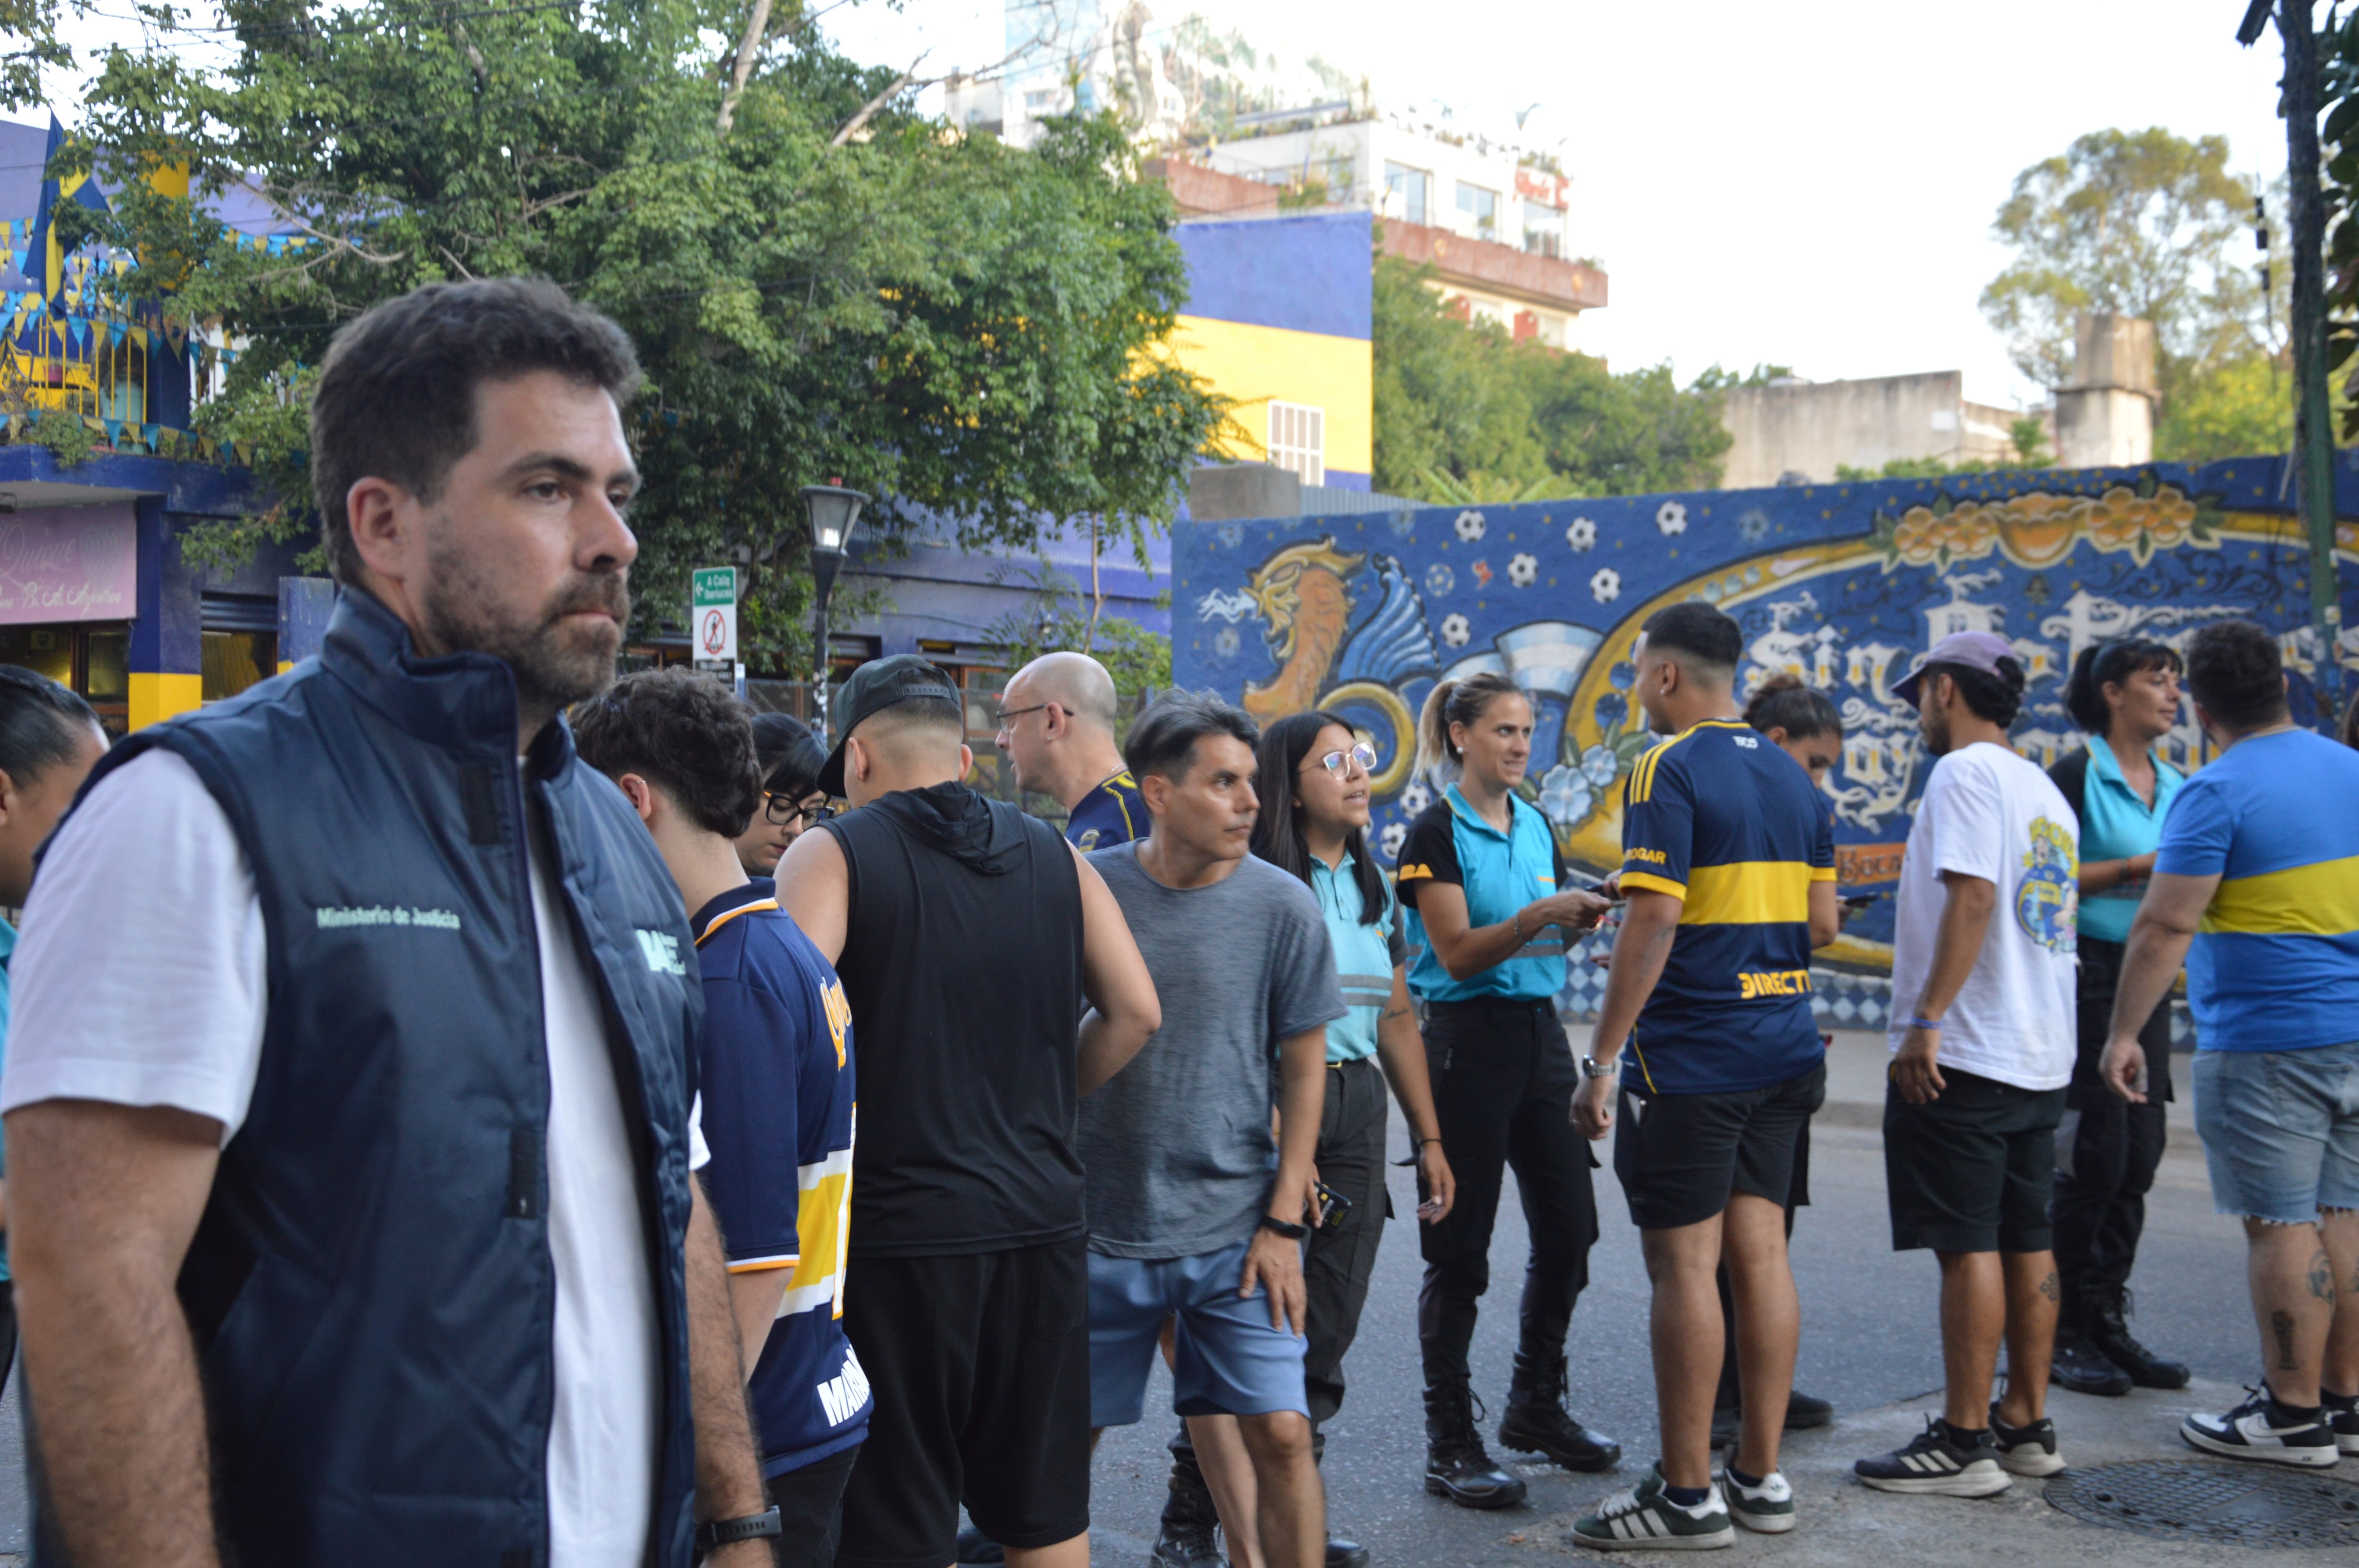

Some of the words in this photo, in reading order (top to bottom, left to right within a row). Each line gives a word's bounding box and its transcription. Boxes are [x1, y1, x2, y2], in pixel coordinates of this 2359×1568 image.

[707, 575, 712, 586] A
[317, 904, 392, 928] Ministerio
[392, 905, 410, 925] de
[412, 906, 460, 930] Justicia
